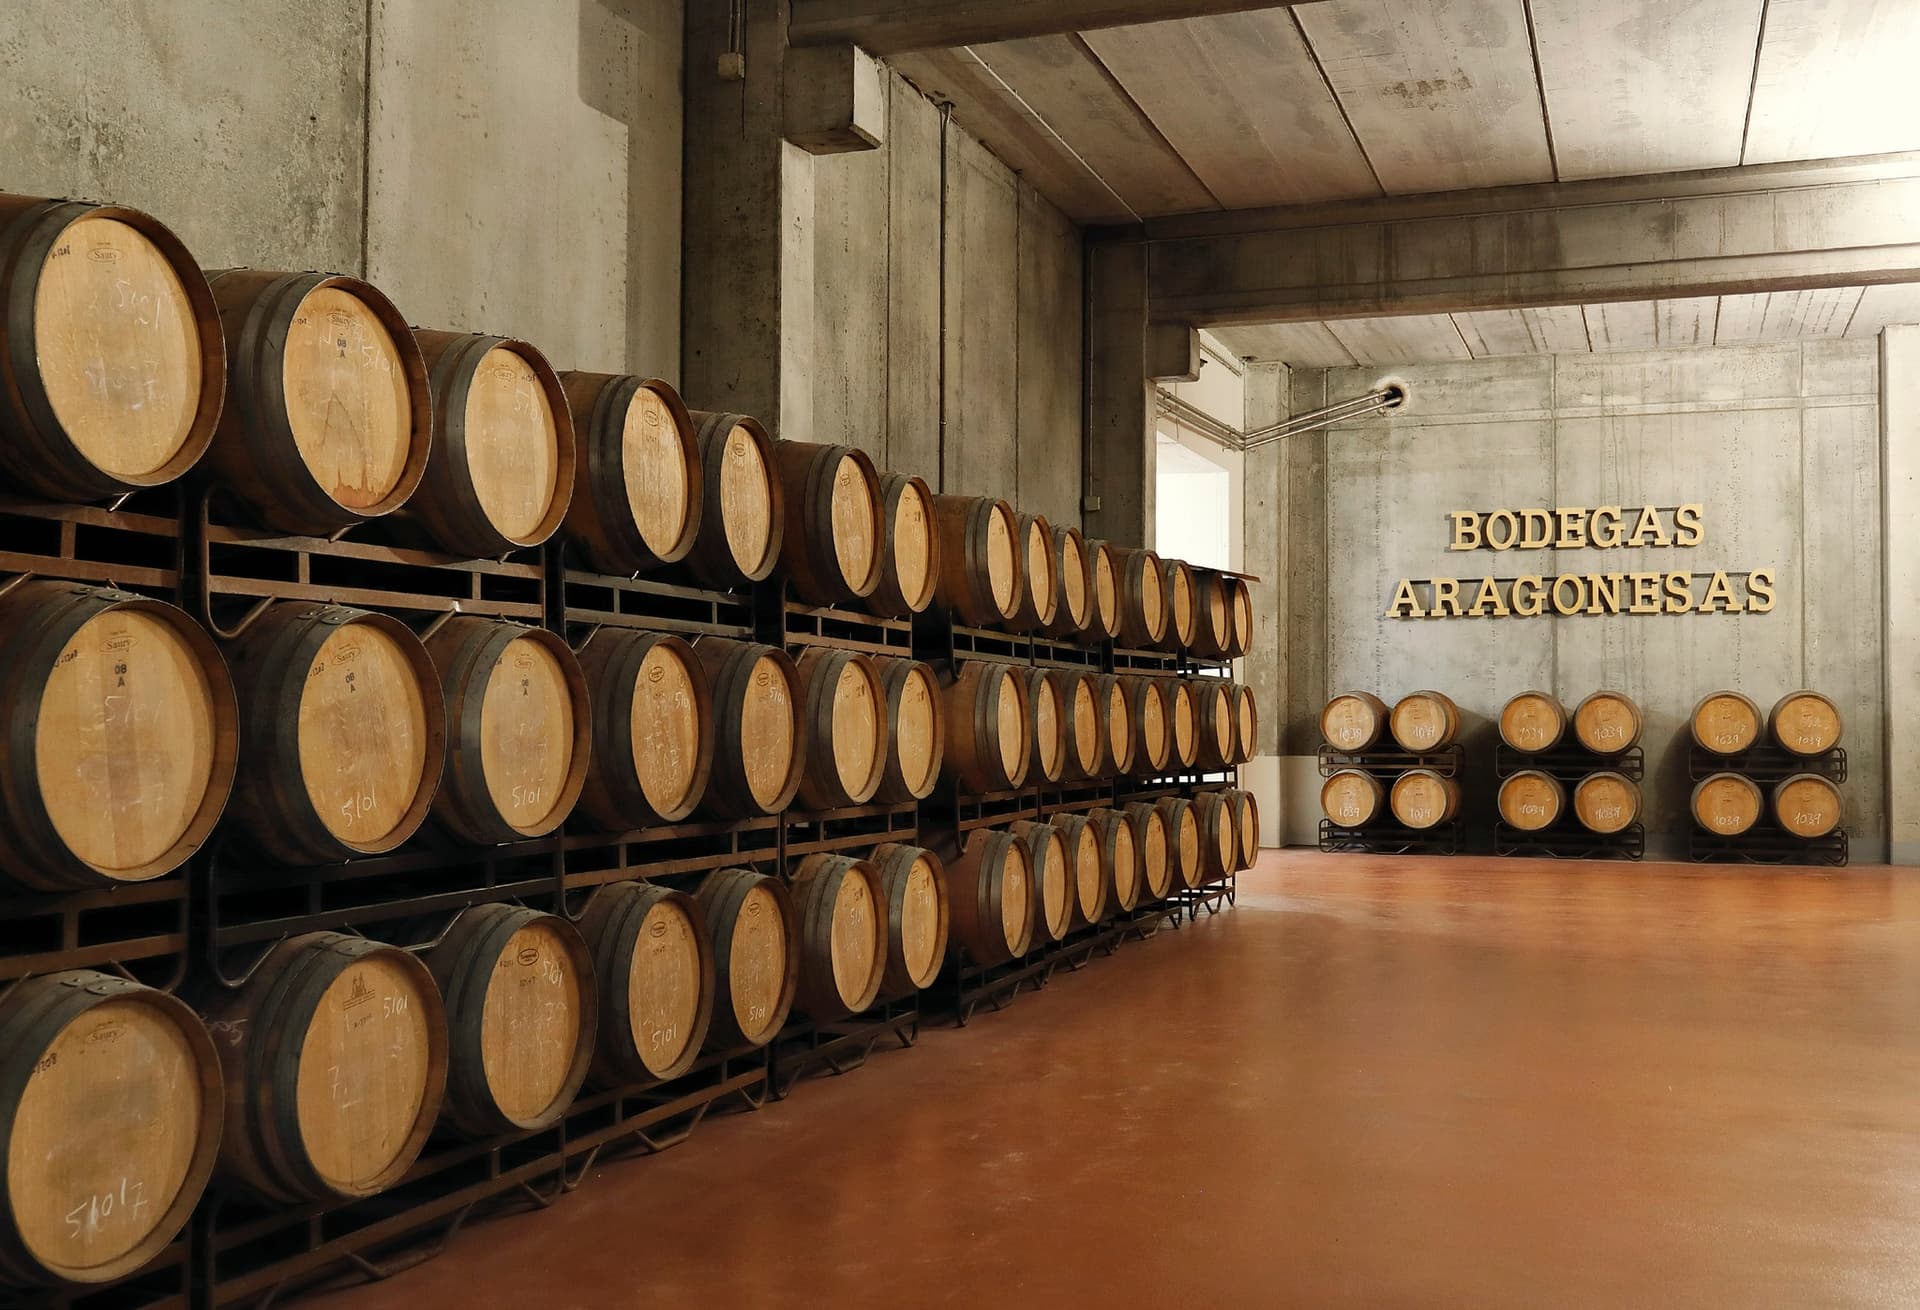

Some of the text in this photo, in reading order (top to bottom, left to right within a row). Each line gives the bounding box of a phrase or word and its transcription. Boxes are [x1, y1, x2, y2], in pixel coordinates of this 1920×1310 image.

[1451, 503, 1705, 551] BODEGAS
[1386, 568, 1777, 617] ARAGONESAS
[341, 789, 377, 826] 5101
[511, 785, 541, 808] 5101
[1340, 807, 1360, 818] 1039
[1794, 812, 1821, 825] 1039
[652, 1023, 677, 1051] 5101
